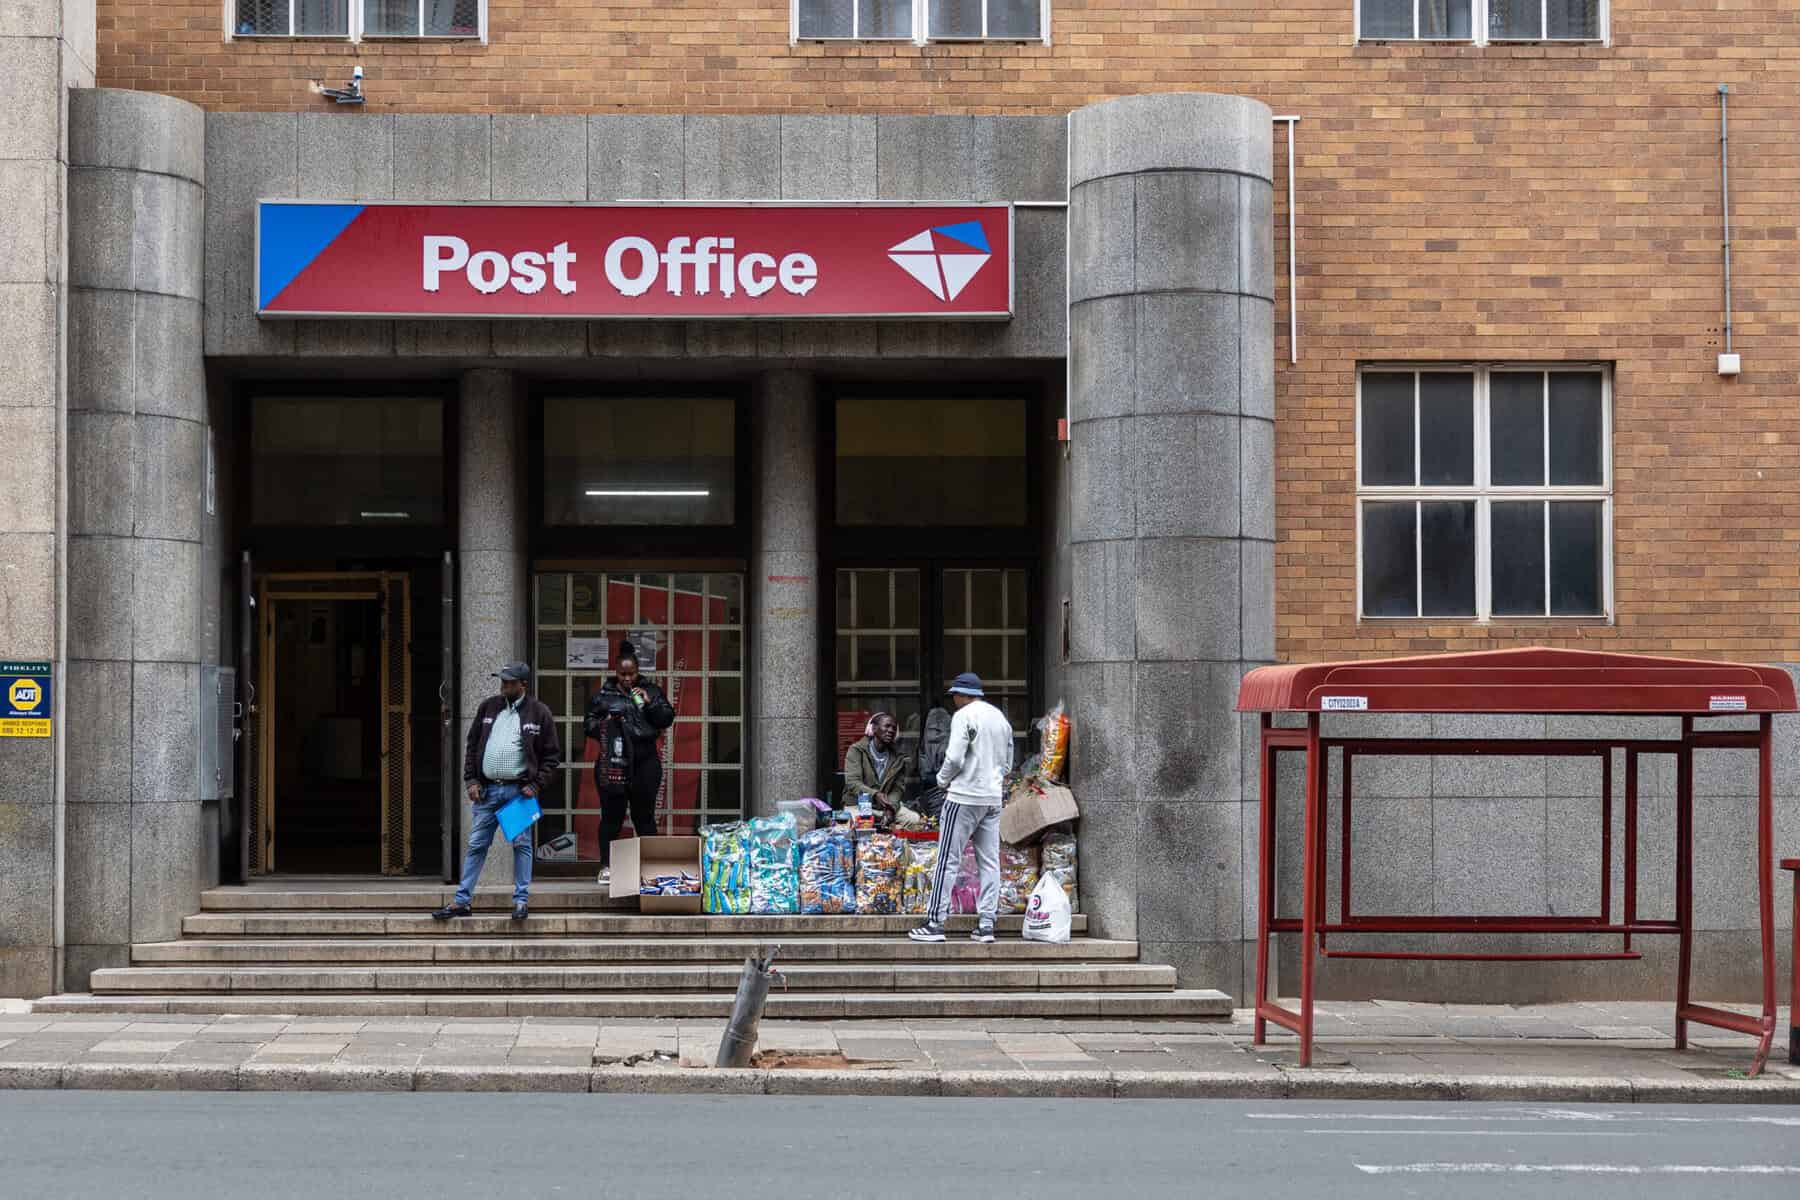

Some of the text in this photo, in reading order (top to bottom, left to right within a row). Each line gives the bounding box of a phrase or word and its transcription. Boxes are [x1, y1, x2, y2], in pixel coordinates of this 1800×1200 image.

[422, 235, 818, 298] Post Office
[16, 689, 35, 700] ADT
